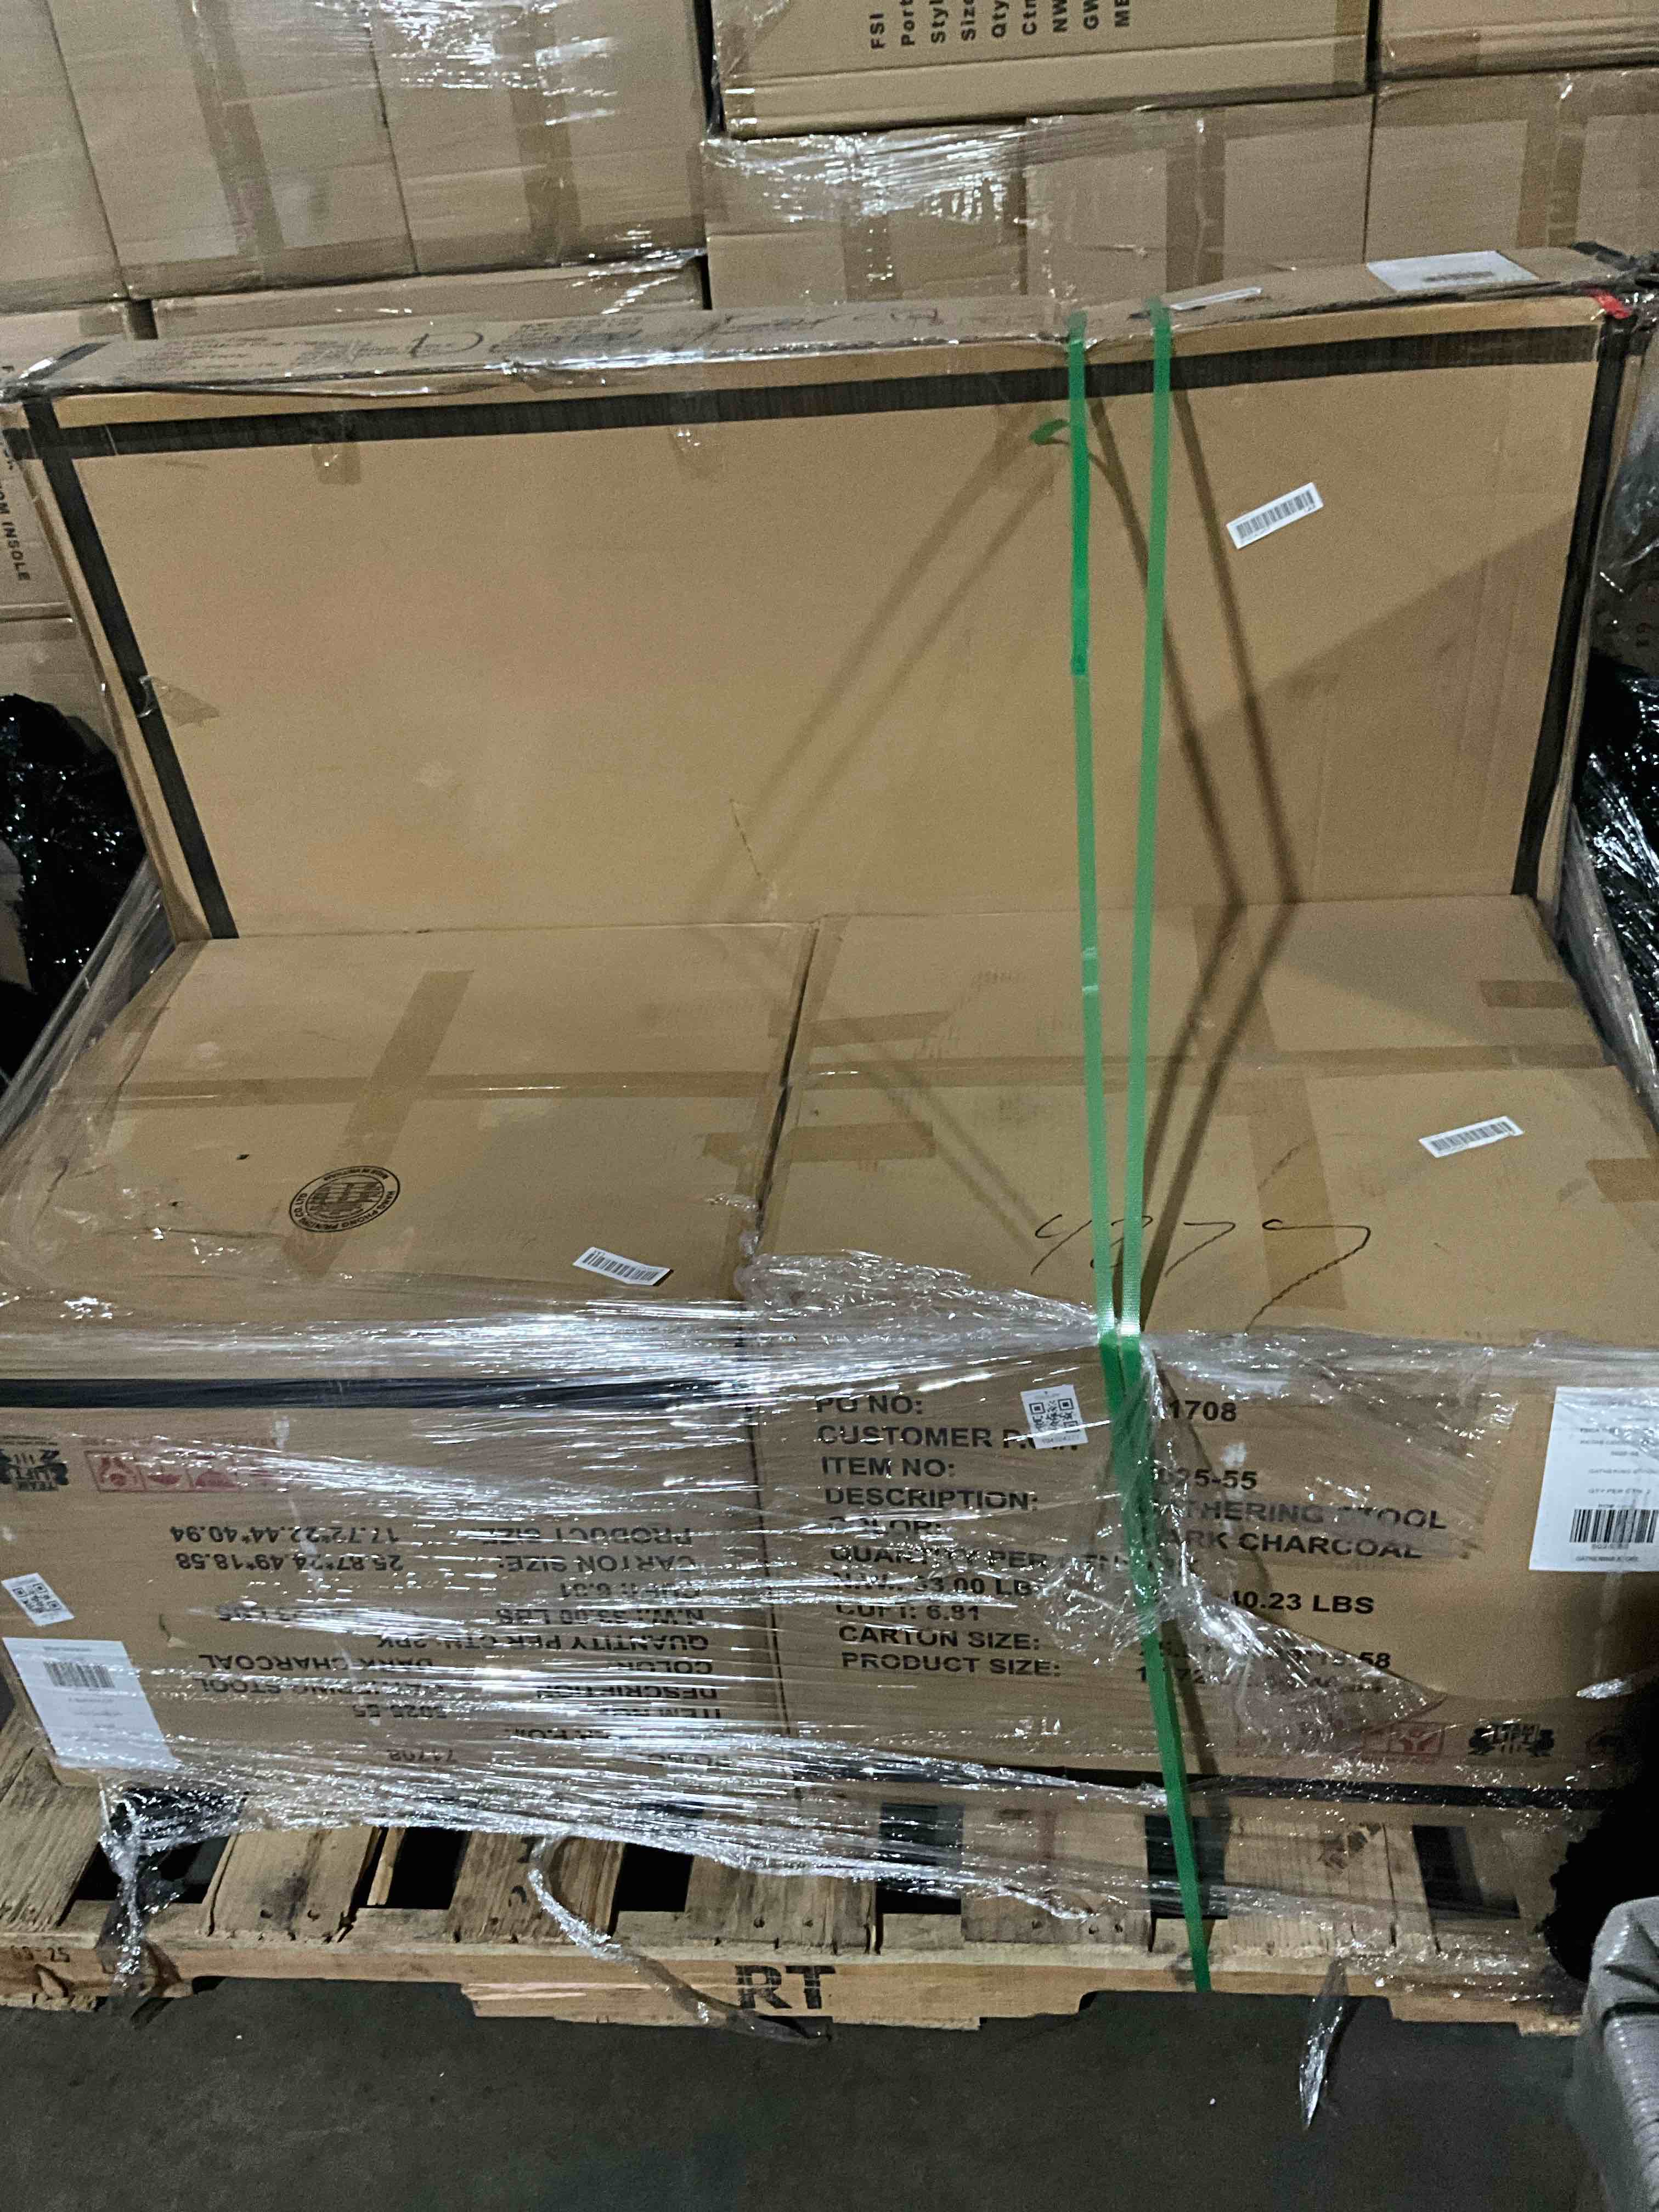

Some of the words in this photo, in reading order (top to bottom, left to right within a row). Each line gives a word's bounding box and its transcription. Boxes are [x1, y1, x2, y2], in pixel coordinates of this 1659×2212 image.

[869, 13, 886, 49] FSI
[991, 0, 1009, 38] Qty
[2, 522, 31, 582] INSOLE
[868, 1395, 922, 1415] NO:
[817, 1425, 993, 1448] CUSTOMER
[822, 1457, 893, 1477] ITEM
[902, 1458, 956, 1478] NO:
[826, 1487, 1038, 1511] DESCRIPTION:
[1238, 1532, 1423, 1559] CHARCOAL
[577, 1555, 696, 1573] CARTON
[1312, 1594, 1374, 1615] LBS
[571, 1635, 709, 1651] QUANTITY
[839, 1624, 958, 1647] CARTON
[968, 1630, 1041, 1651] SIZE:
[198, 1654, 351, 1671] CHARCOAL
[841, 1651, 981, 1673] PRODUCT
[989, 1657, 1062, 1677] SIZE:
[735, 1964, 836, 2010] RT
